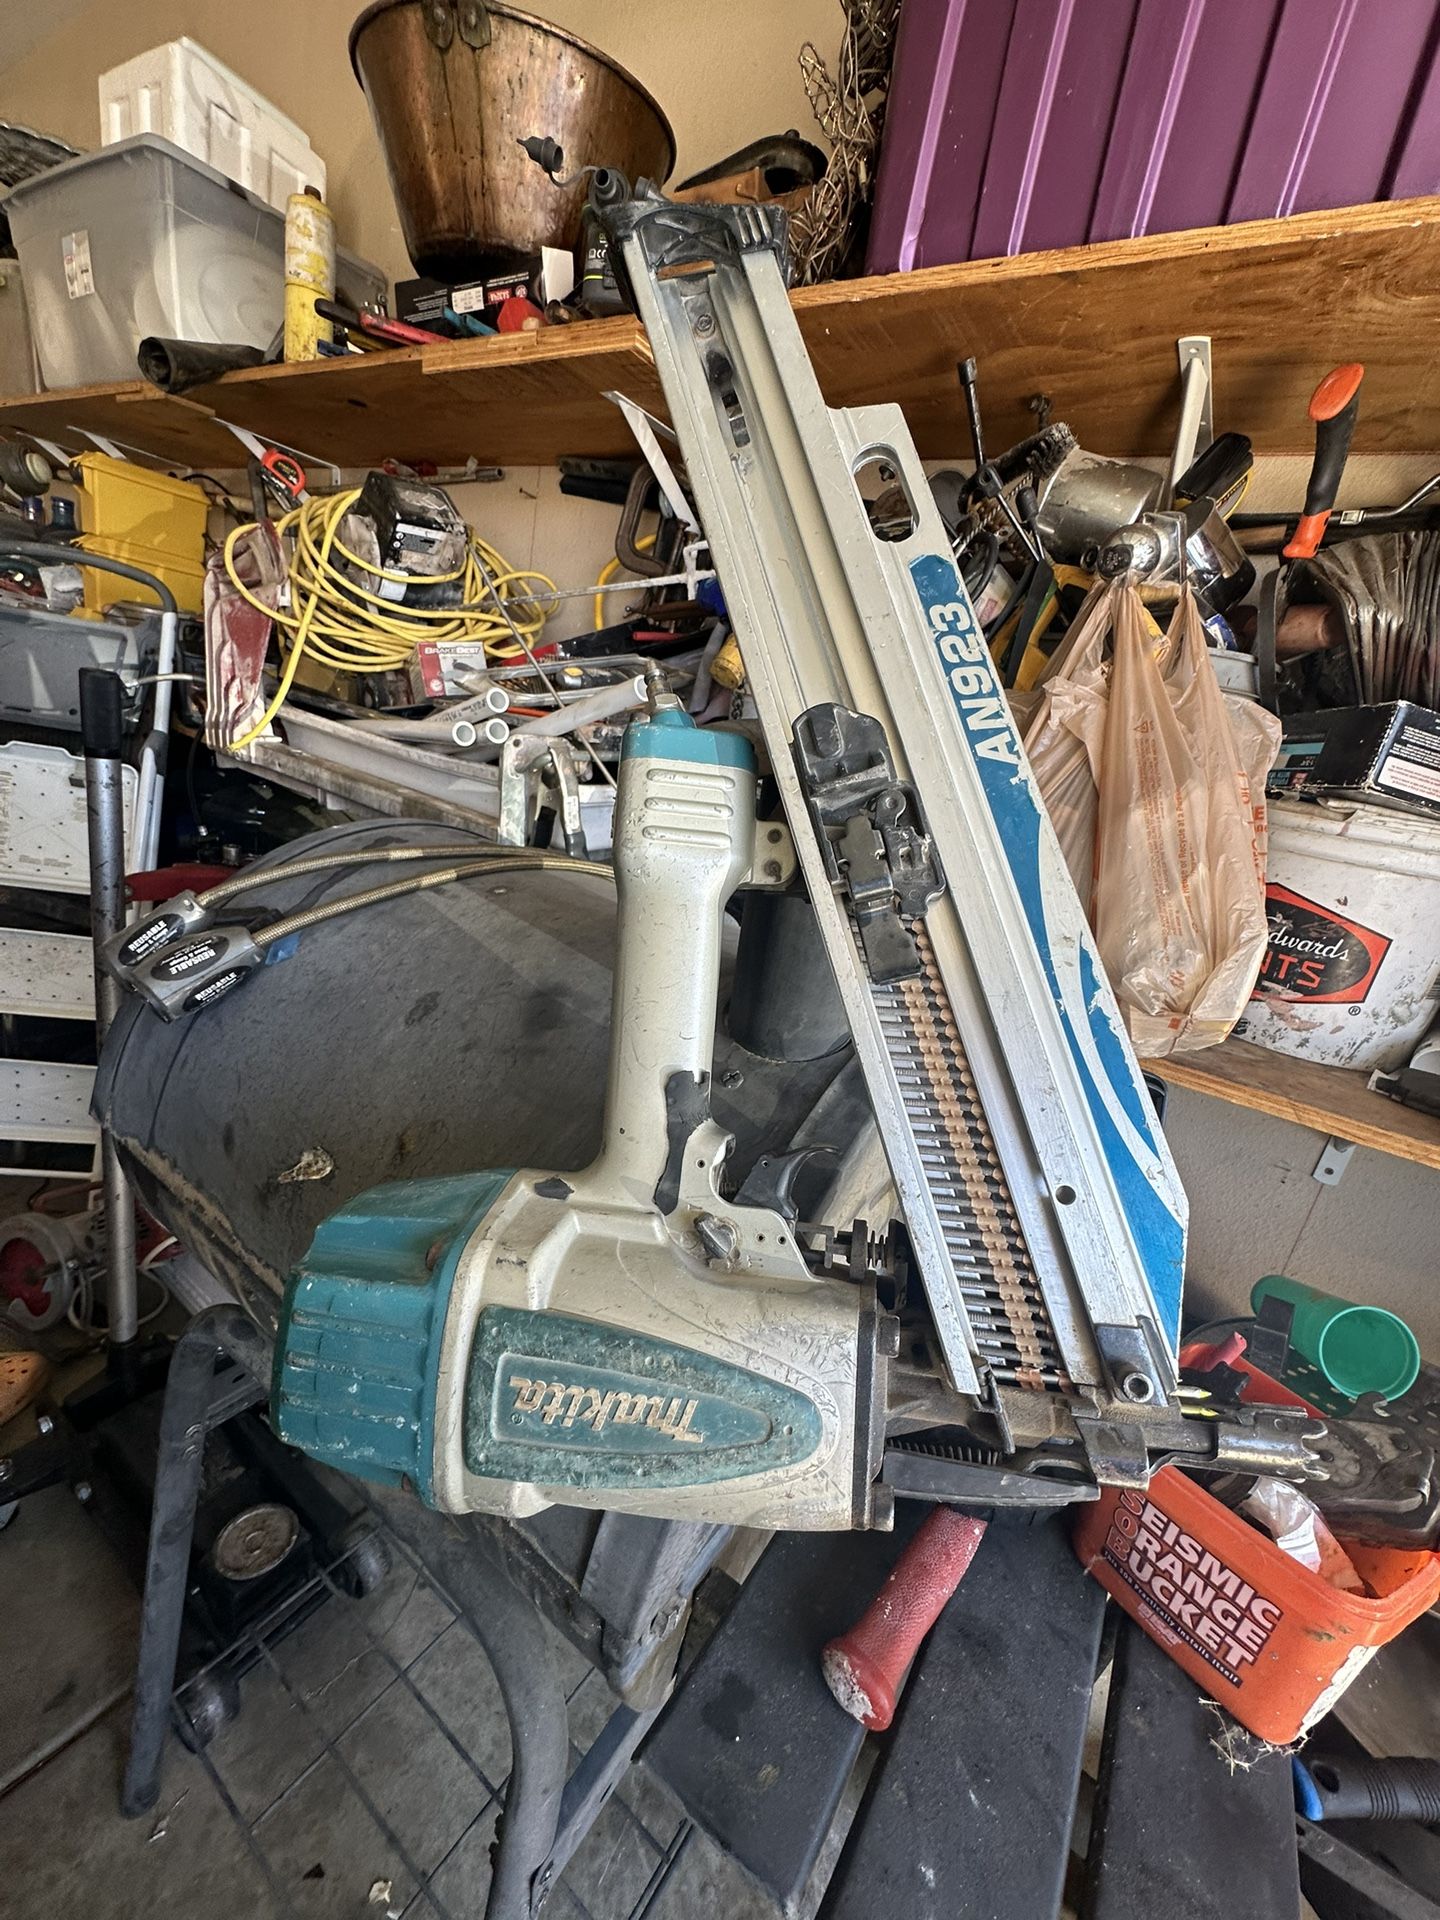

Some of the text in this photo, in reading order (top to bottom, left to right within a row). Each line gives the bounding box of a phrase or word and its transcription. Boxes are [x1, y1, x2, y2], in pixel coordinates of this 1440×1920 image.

[929, 602, 1020, 765] AN923
[128, 920, 167, 951] REUSABLE
[168, 948, 216, 975] REUSABLE
[194, 971, 237, 1001] REUSABLE
[1105, 1526, 1257, 1670] BUCKET
[1113, 1506, 1269, 1653] ORANGE
[1120, 1489, 1284, 1632] SEISMIC
[1133, 1582, 1176, 1627] Practically
